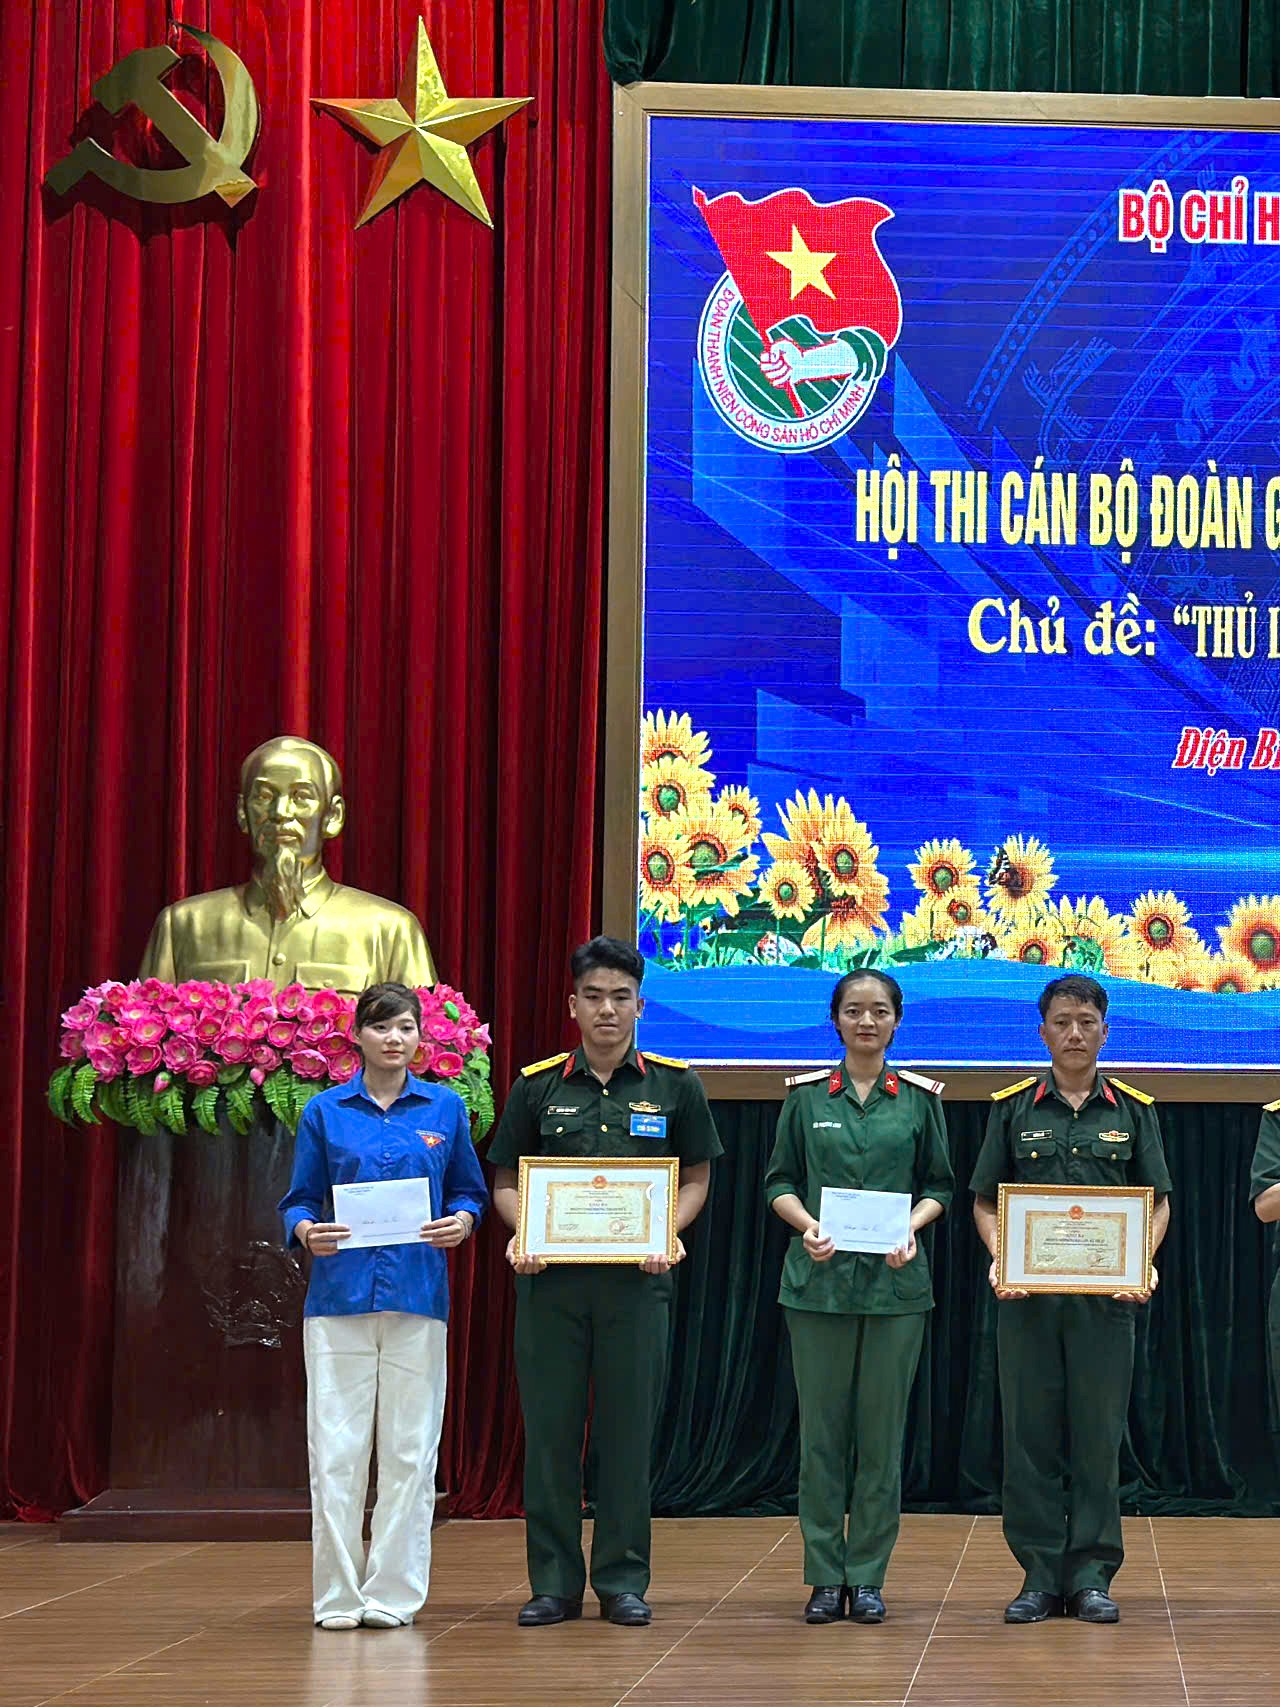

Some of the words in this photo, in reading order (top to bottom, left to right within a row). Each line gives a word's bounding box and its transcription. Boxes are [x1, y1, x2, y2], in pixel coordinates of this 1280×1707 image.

[1119, 180, 1173, 253] BỘ
[1180, 176, 1248, 244] CHỈ
[706, 331, 723, 380] THANH
[838, 384, 865, 419] MINH
[856, 453, 918, 560] HỘI
[930, 471, 987, 543] THI
[1001, 456, 1077, 545] CÁN
[1090, 458, 1138, 563] BỘ
[1150, 460, 1252, 548] ĐOÀN
[968, 596, 1067, 654] Chủ
[1085, 593, 1155, 656] đề:
[1174, 592, 1256, 658] “THỦ
[1173, 727, 1246, 777] Điện
